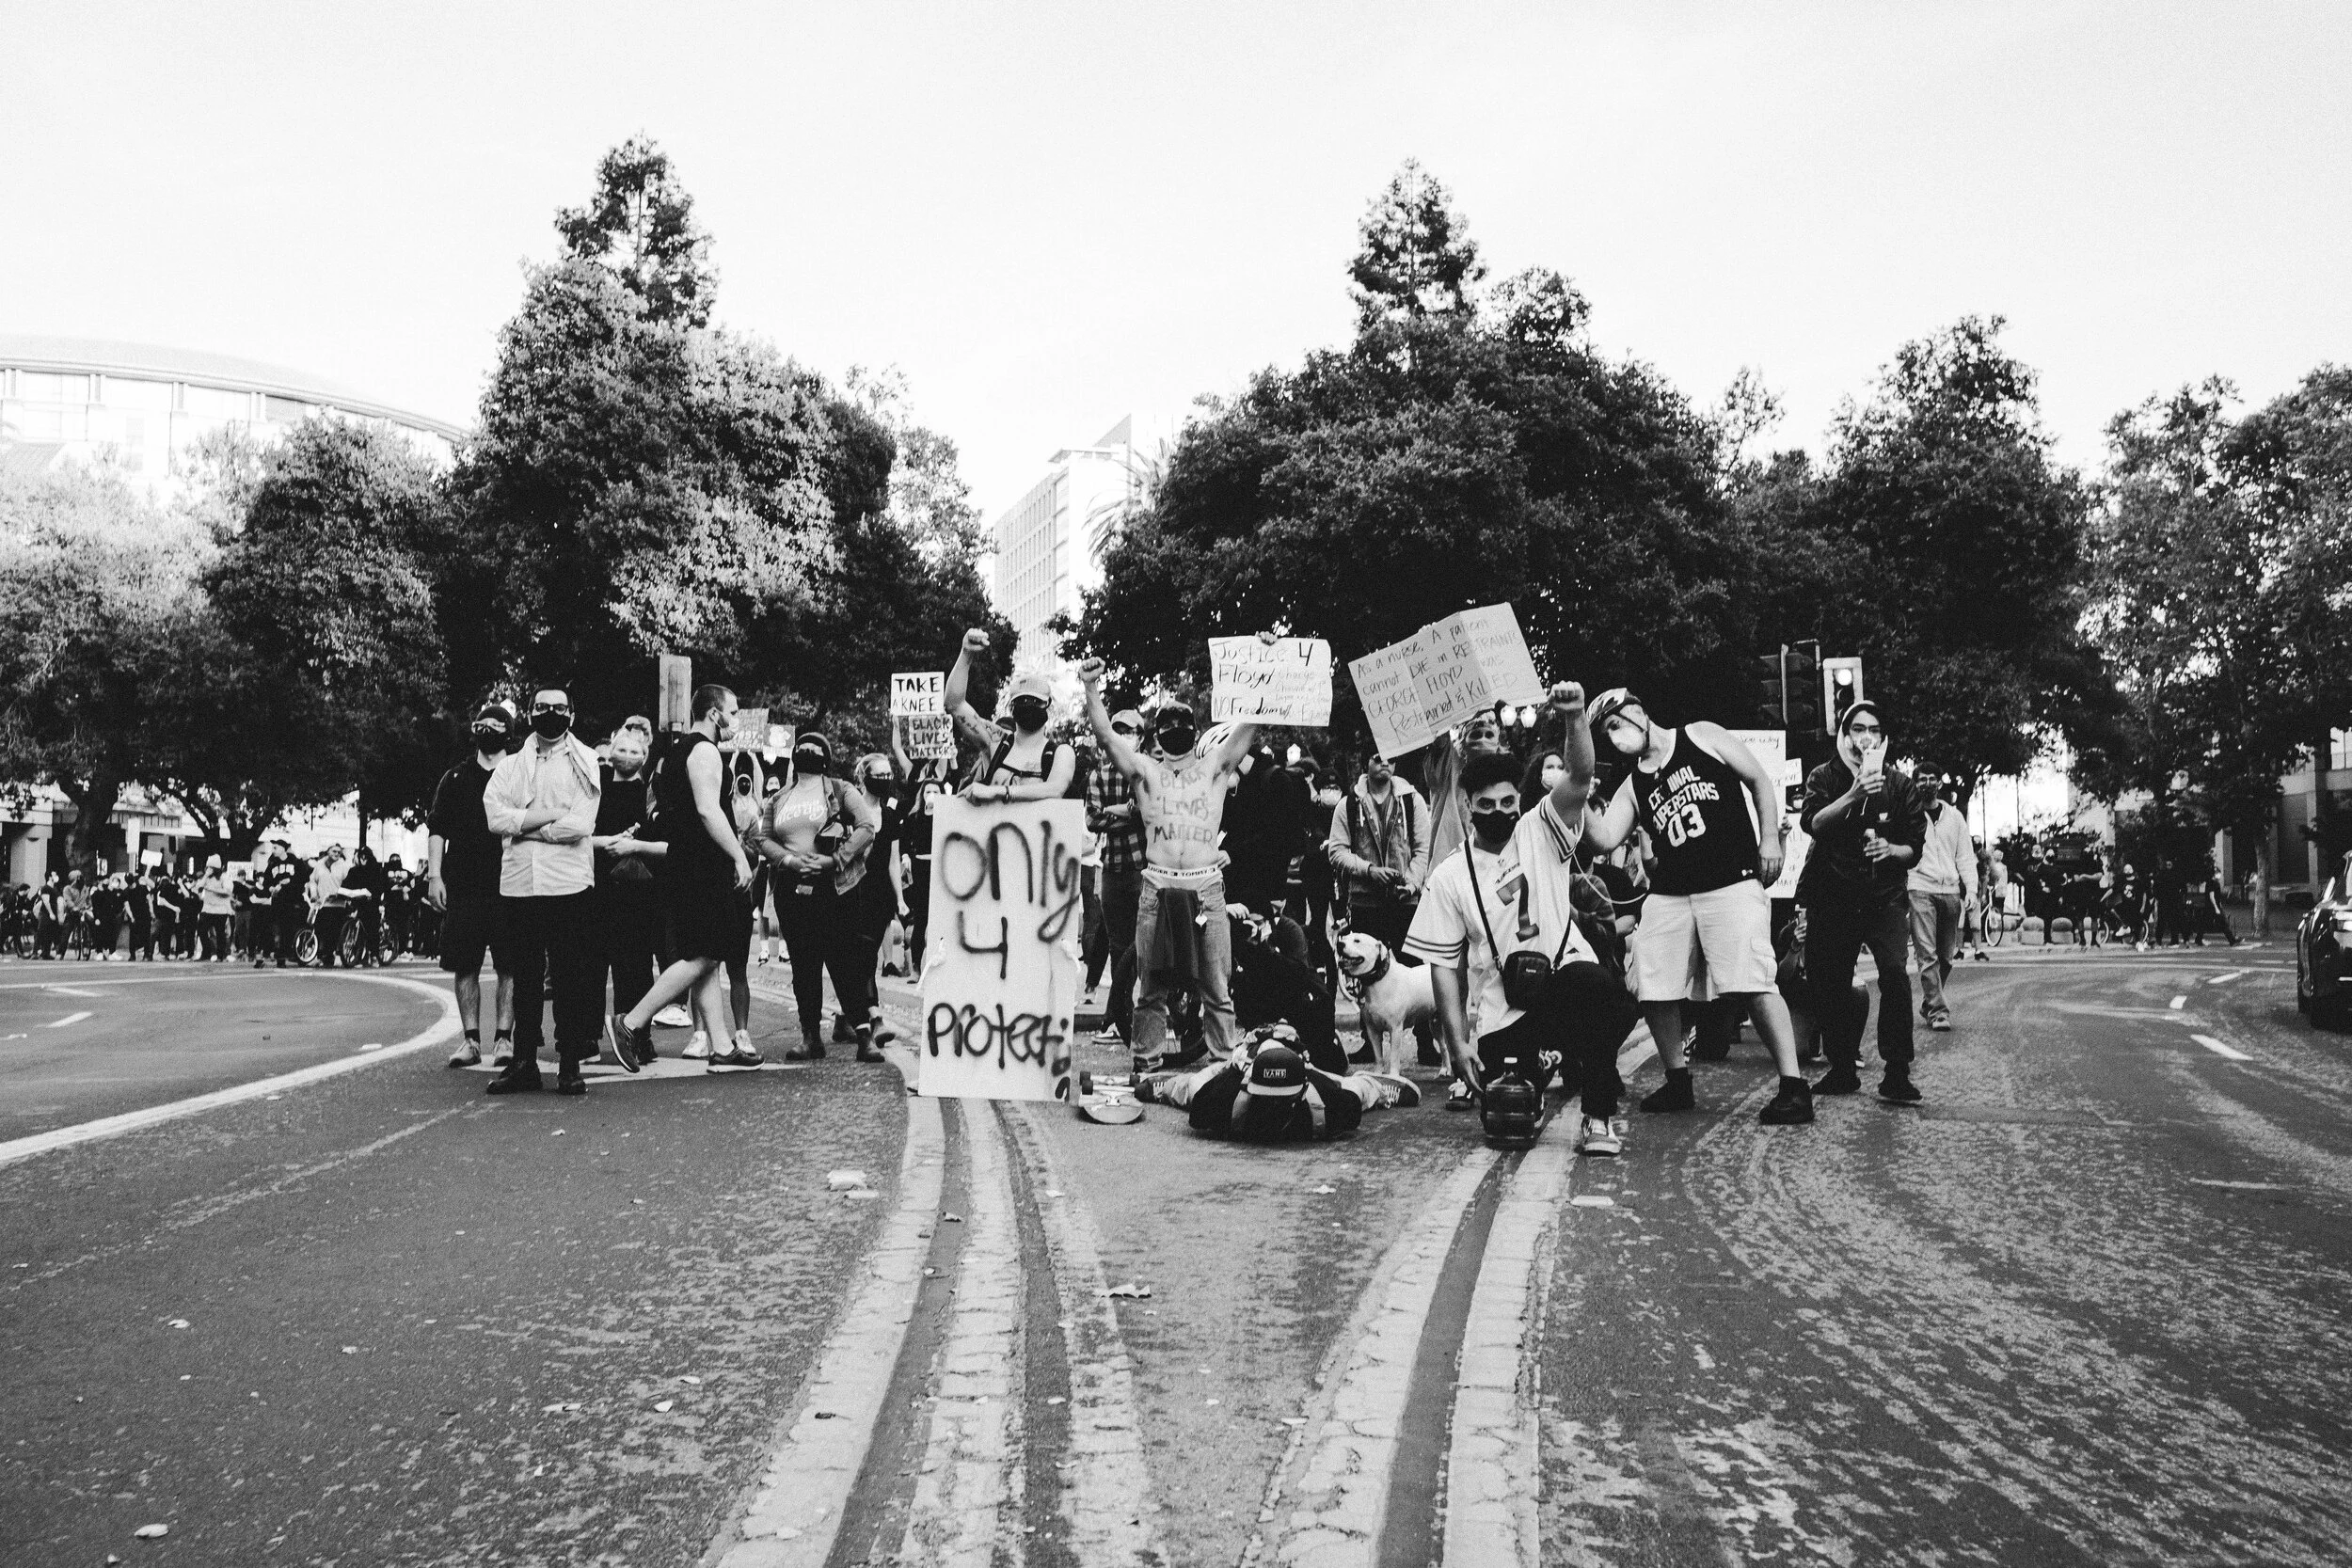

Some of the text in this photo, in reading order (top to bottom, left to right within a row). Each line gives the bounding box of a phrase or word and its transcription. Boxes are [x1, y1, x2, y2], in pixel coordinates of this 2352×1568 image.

[1299, 642, 1313, 666] 4
[1218, 662, 1275, 689] Floyd
[1409, 657, 1430, 678] DIE
[1425, 665, 1462, 694] FLOYD
[895, 676, 941, 693] TAKE
[901, 696, 936, 712] KNEE
[912, 717, 950, 731] BLACK
[1153, 822, 1214, 845] MATTER
[1668, 802, 1706, 847] 03
[1496, 872, 1539, 942] 7
[958, 910, 1008, 979] 4
